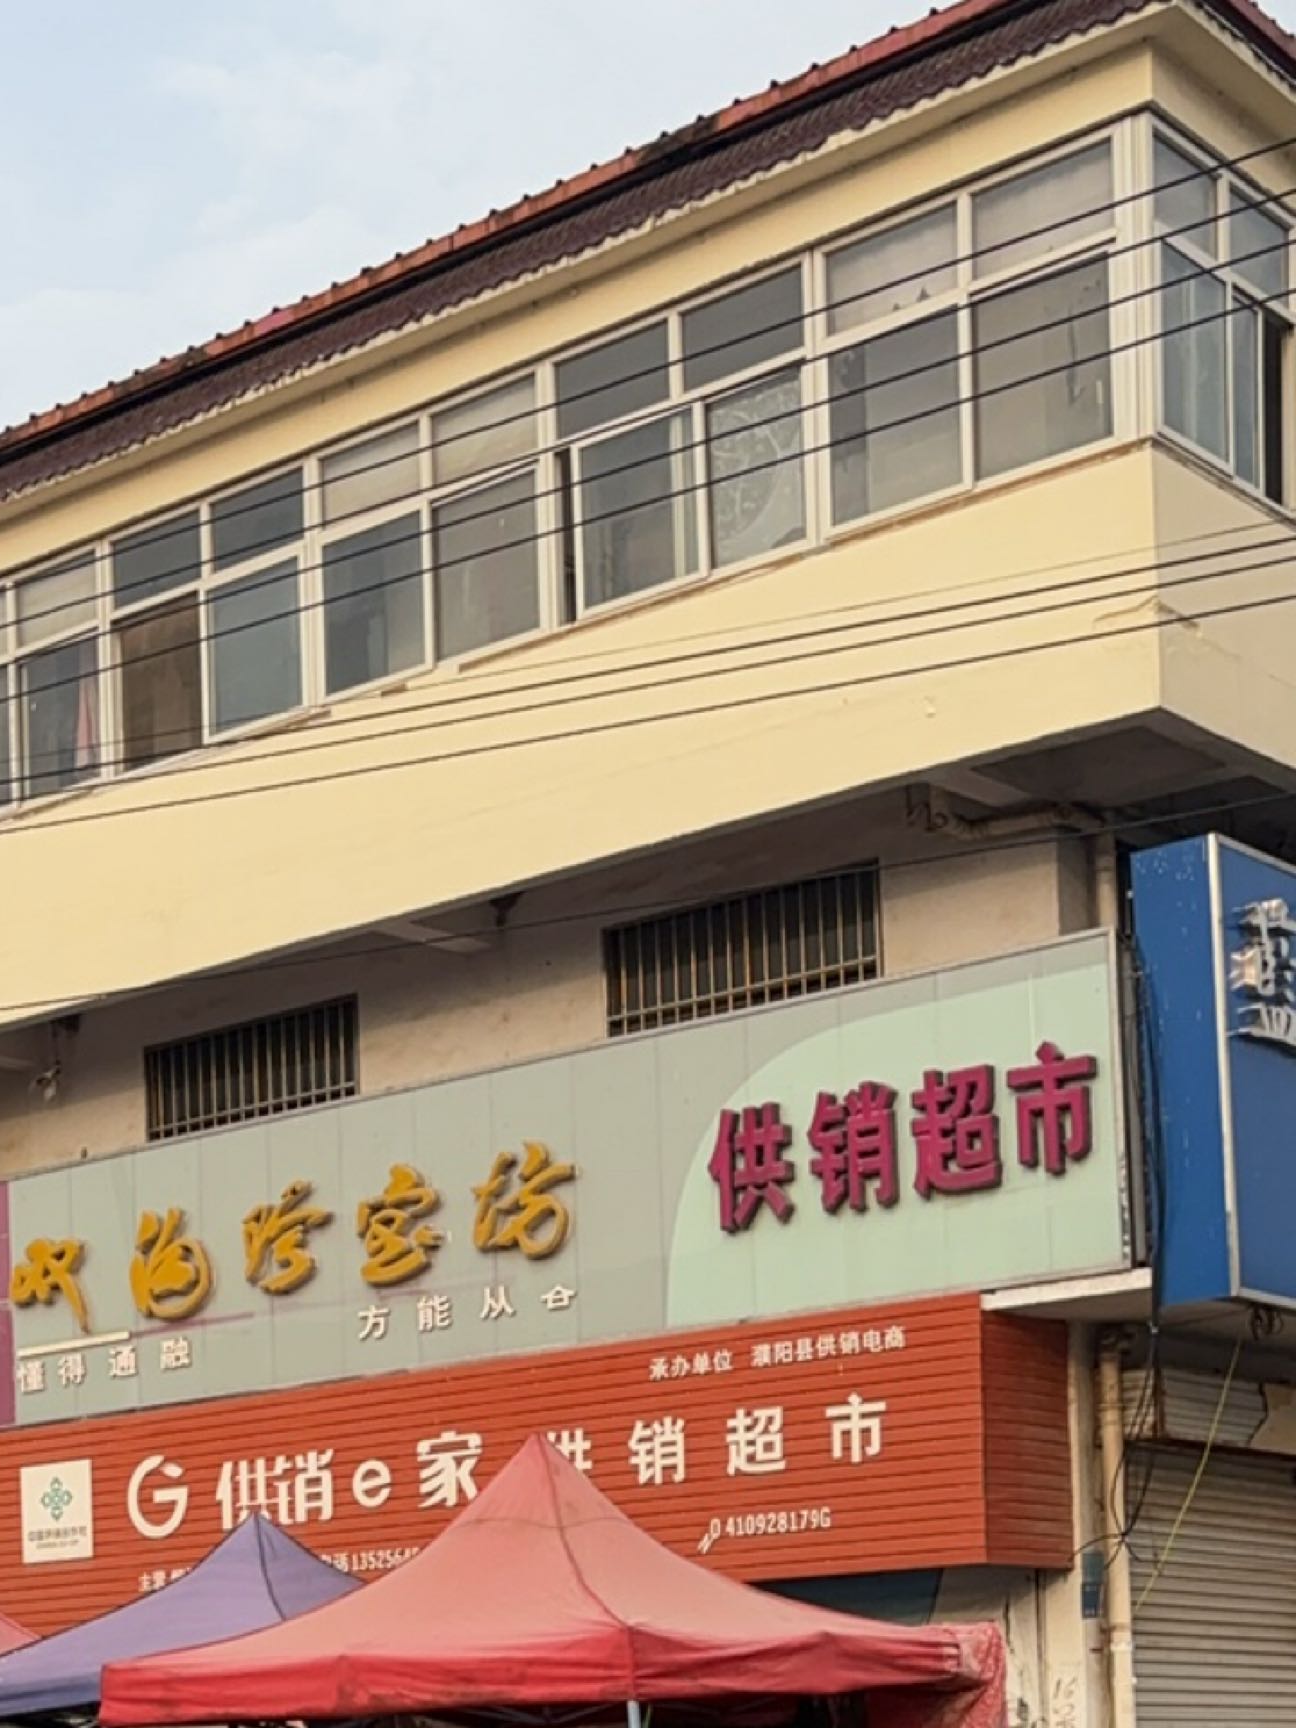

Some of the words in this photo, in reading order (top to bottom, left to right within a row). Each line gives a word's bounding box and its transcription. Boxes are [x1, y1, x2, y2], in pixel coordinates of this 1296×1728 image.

[708, 1042, 1098, 1234] 供销超市
[16, 1336, 192, 1393] 懂得通融
[649, 1349, 733, 1381] 承办单位
[215, 1430, 484, 1531] 供销e家
